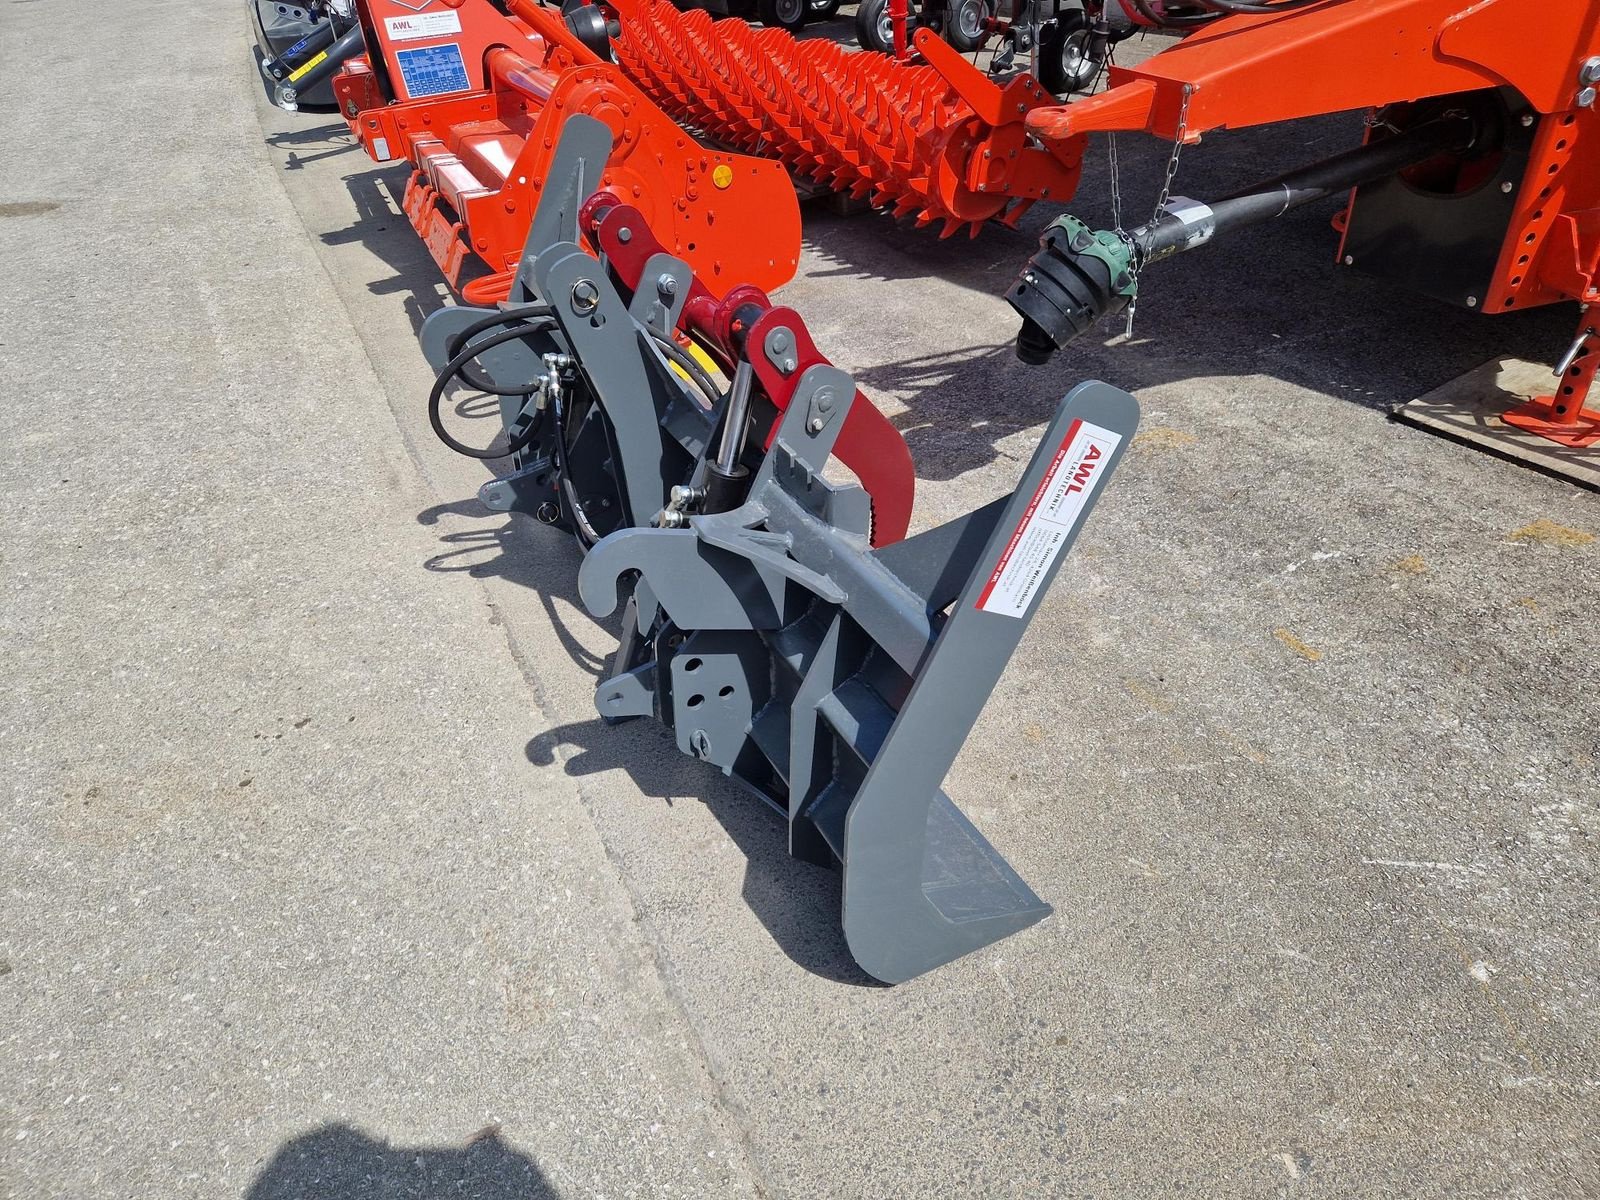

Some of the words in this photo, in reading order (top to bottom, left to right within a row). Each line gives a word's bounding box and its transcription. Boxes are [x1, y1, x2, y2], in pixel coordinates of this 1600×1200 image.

[392, 21, 413, 31] AWL
[1056, 449, 1065, 458] Die
[1047, 459, 1060, 476] Arbeit
[1064, 444, 1102, 496] AWL
[1049, 461, 1079, 511] LANDTECHNIK
[1025, 507, 1034, 517] mit
[1037, 547, 1053, 568] Simon
[990, 571, 1000, 583] AWL
